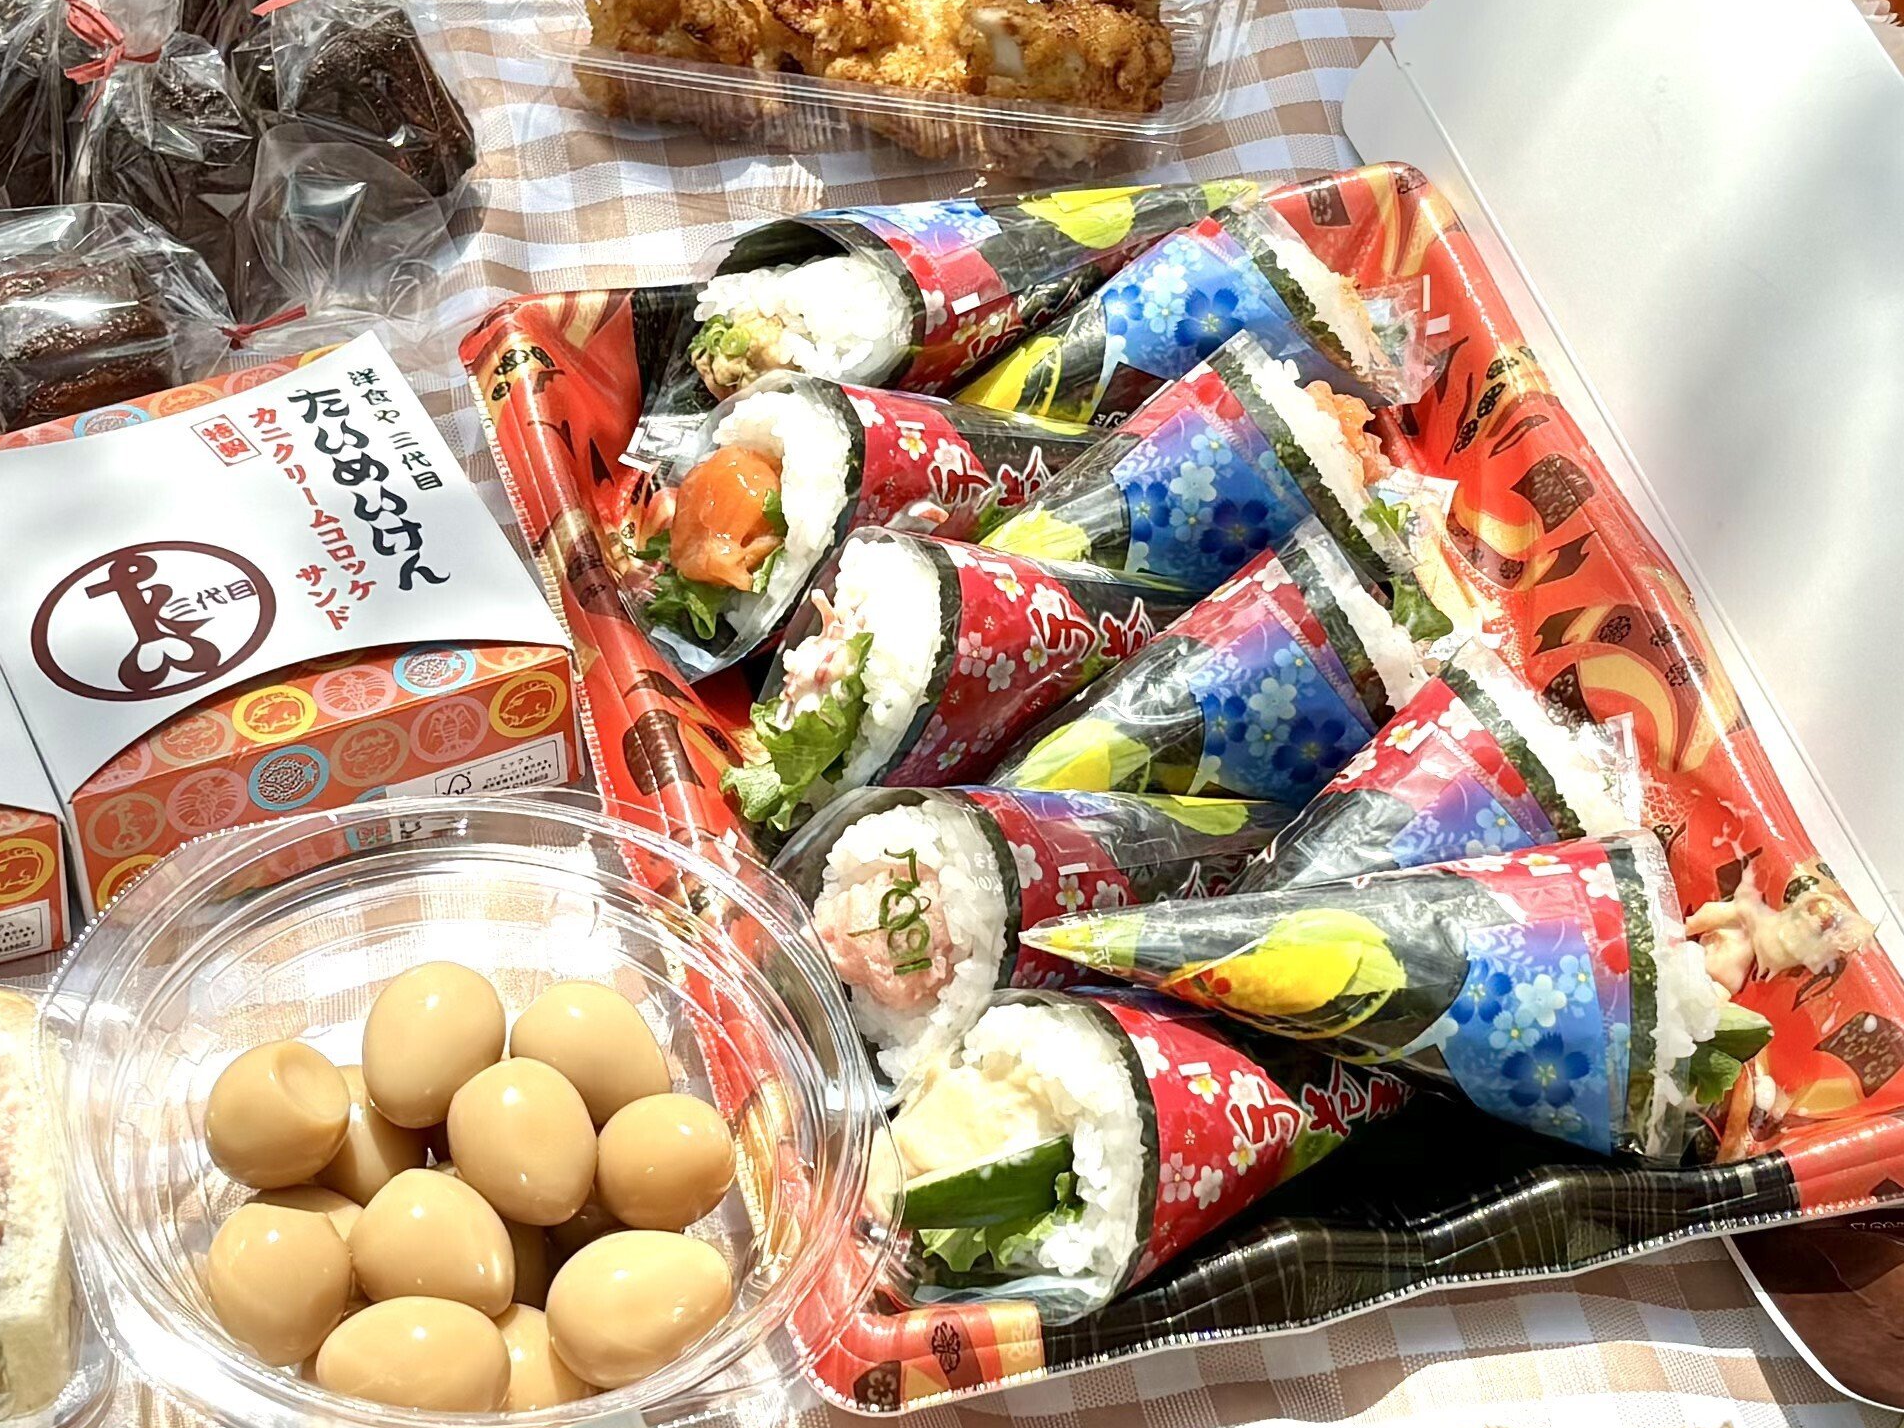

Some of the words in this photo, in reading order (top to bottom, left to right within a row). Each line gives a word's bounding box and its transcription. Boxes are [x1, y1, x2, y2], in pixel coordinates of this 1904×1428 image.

[287, 387, 451, 591] たいめいけん
[388, 431, 444, 492] 三代目
[248, 407, 378, 602] カニクリームコロッケ
[166, 579, 258, 622] 三代目
[295, 563, 350, 631] サンド
